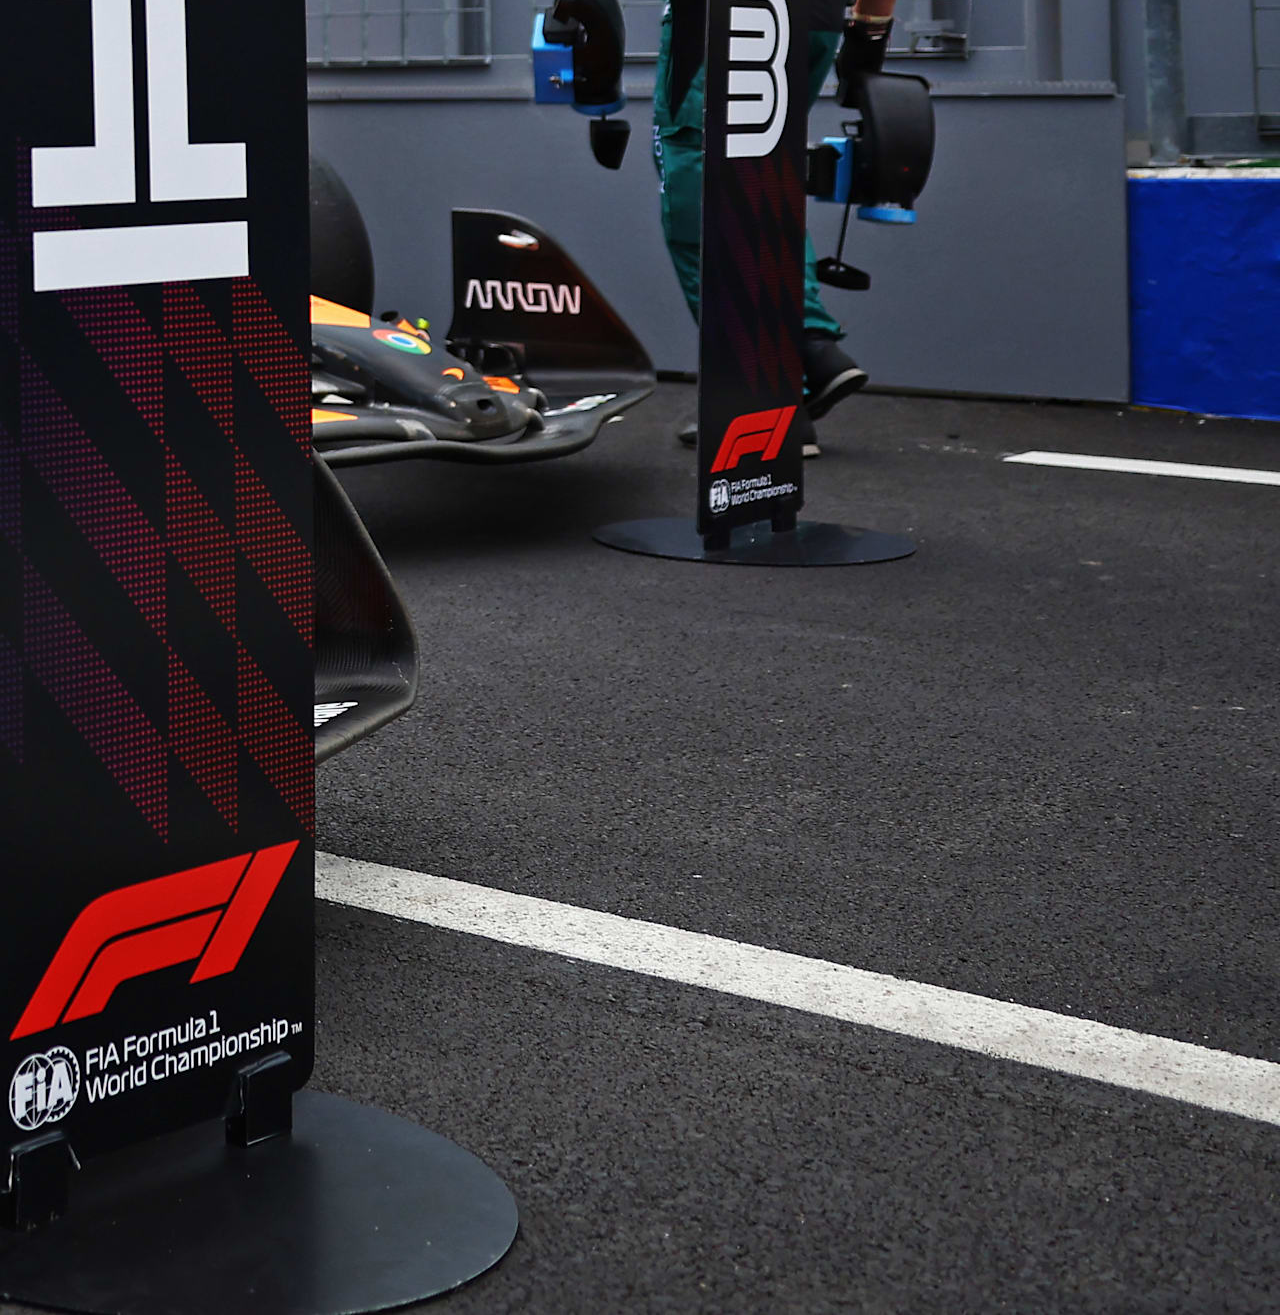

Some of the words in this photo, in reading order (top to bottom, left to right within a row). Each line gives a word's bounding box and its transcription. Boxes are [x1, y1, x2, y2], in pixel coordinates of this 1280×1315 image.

[465, 280, 581, 315] ARROW
[85, 1042, 120, 1075] FIA
[123, 1016, 206, 1062] Formula
[208, 1010, 221, 1036] 1
[85, 1061, 148, 1104] World
